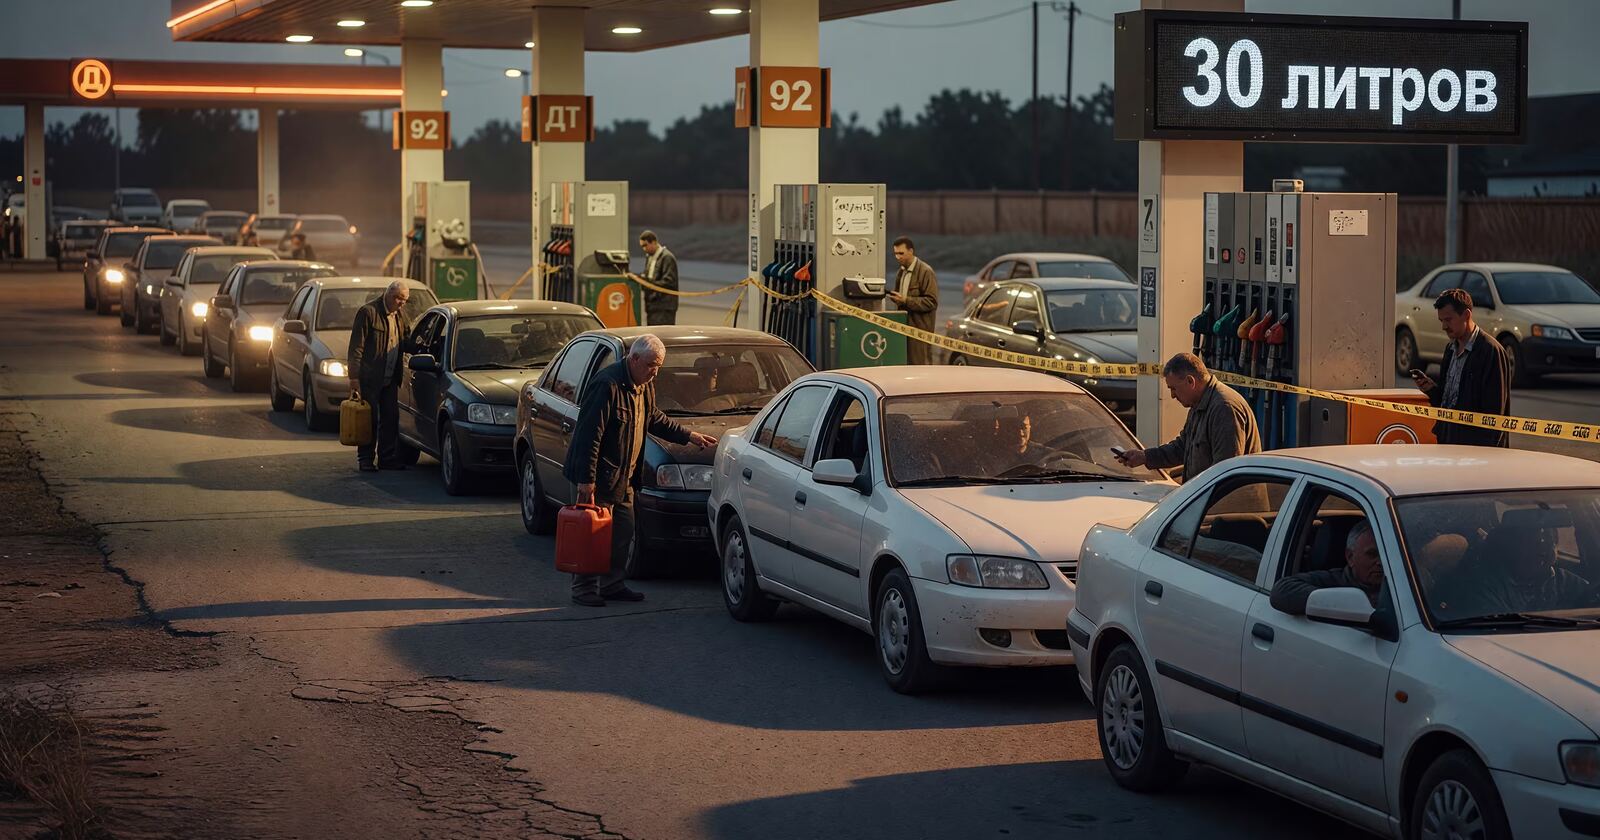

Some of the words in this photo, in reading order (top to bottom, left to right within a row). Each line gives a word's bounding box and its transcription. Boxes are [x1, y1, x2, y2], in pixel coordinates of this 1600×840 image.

[769, 79, 813, 111] 92
[1182, 37, 1264, 108] 30
[1281, 65, 1498, 125] литров
[410, 118, 439, 140] 92
[544, 105, 581, 133] ДТ
